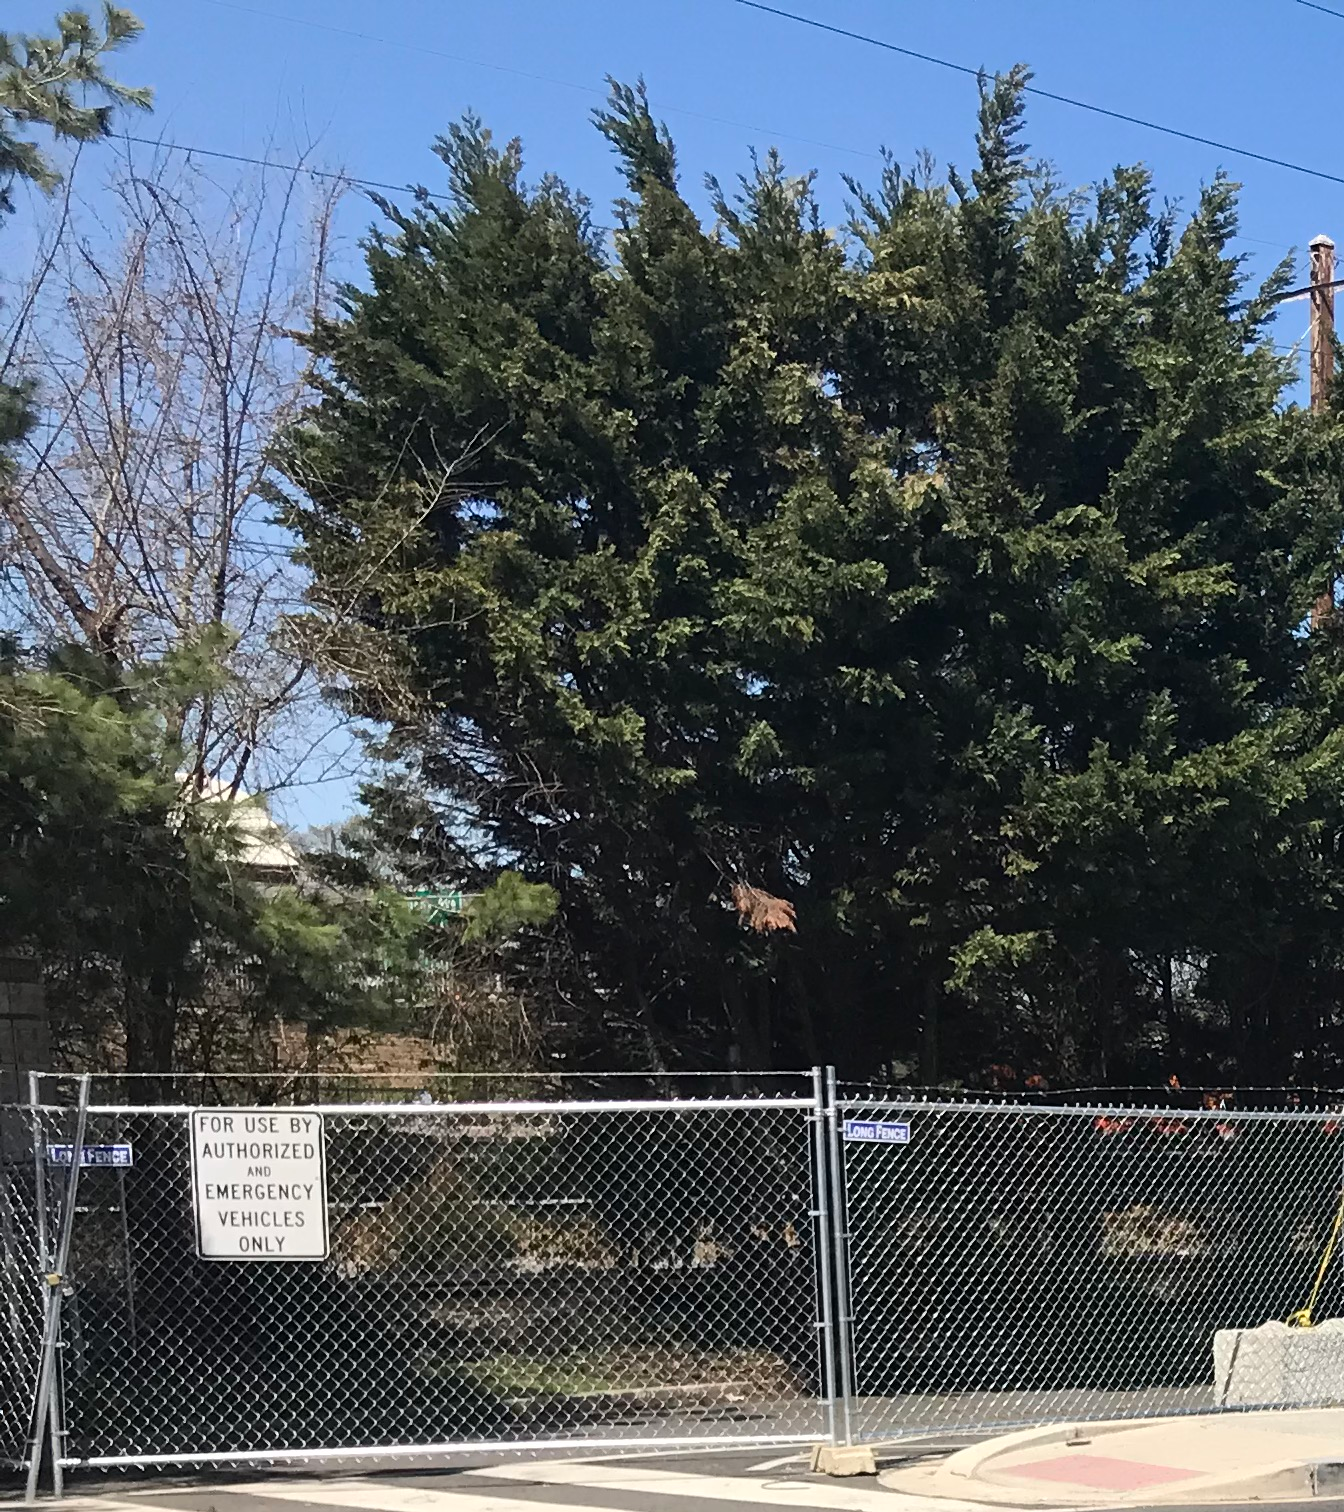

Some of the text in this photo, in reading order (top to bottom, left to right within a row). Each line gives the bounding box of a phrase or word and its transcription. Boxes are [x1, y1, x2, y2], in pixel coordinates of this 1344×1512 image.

[200, 1117, 312, 1133] FOR USE BY
[847, 1123, 907, 1139] LONG FENCE
[87, 1149, 128, 1162] FENCE
[202, 1143, 315, 1159] AUTHORIZED
[247, 1166, 272, 1177] AND
[205, 1184, 314, 1200] EMERGENCY
[218, 1211, 305, 1227] VEHICLES
[239, 1236, 286, 1252] ONLY
